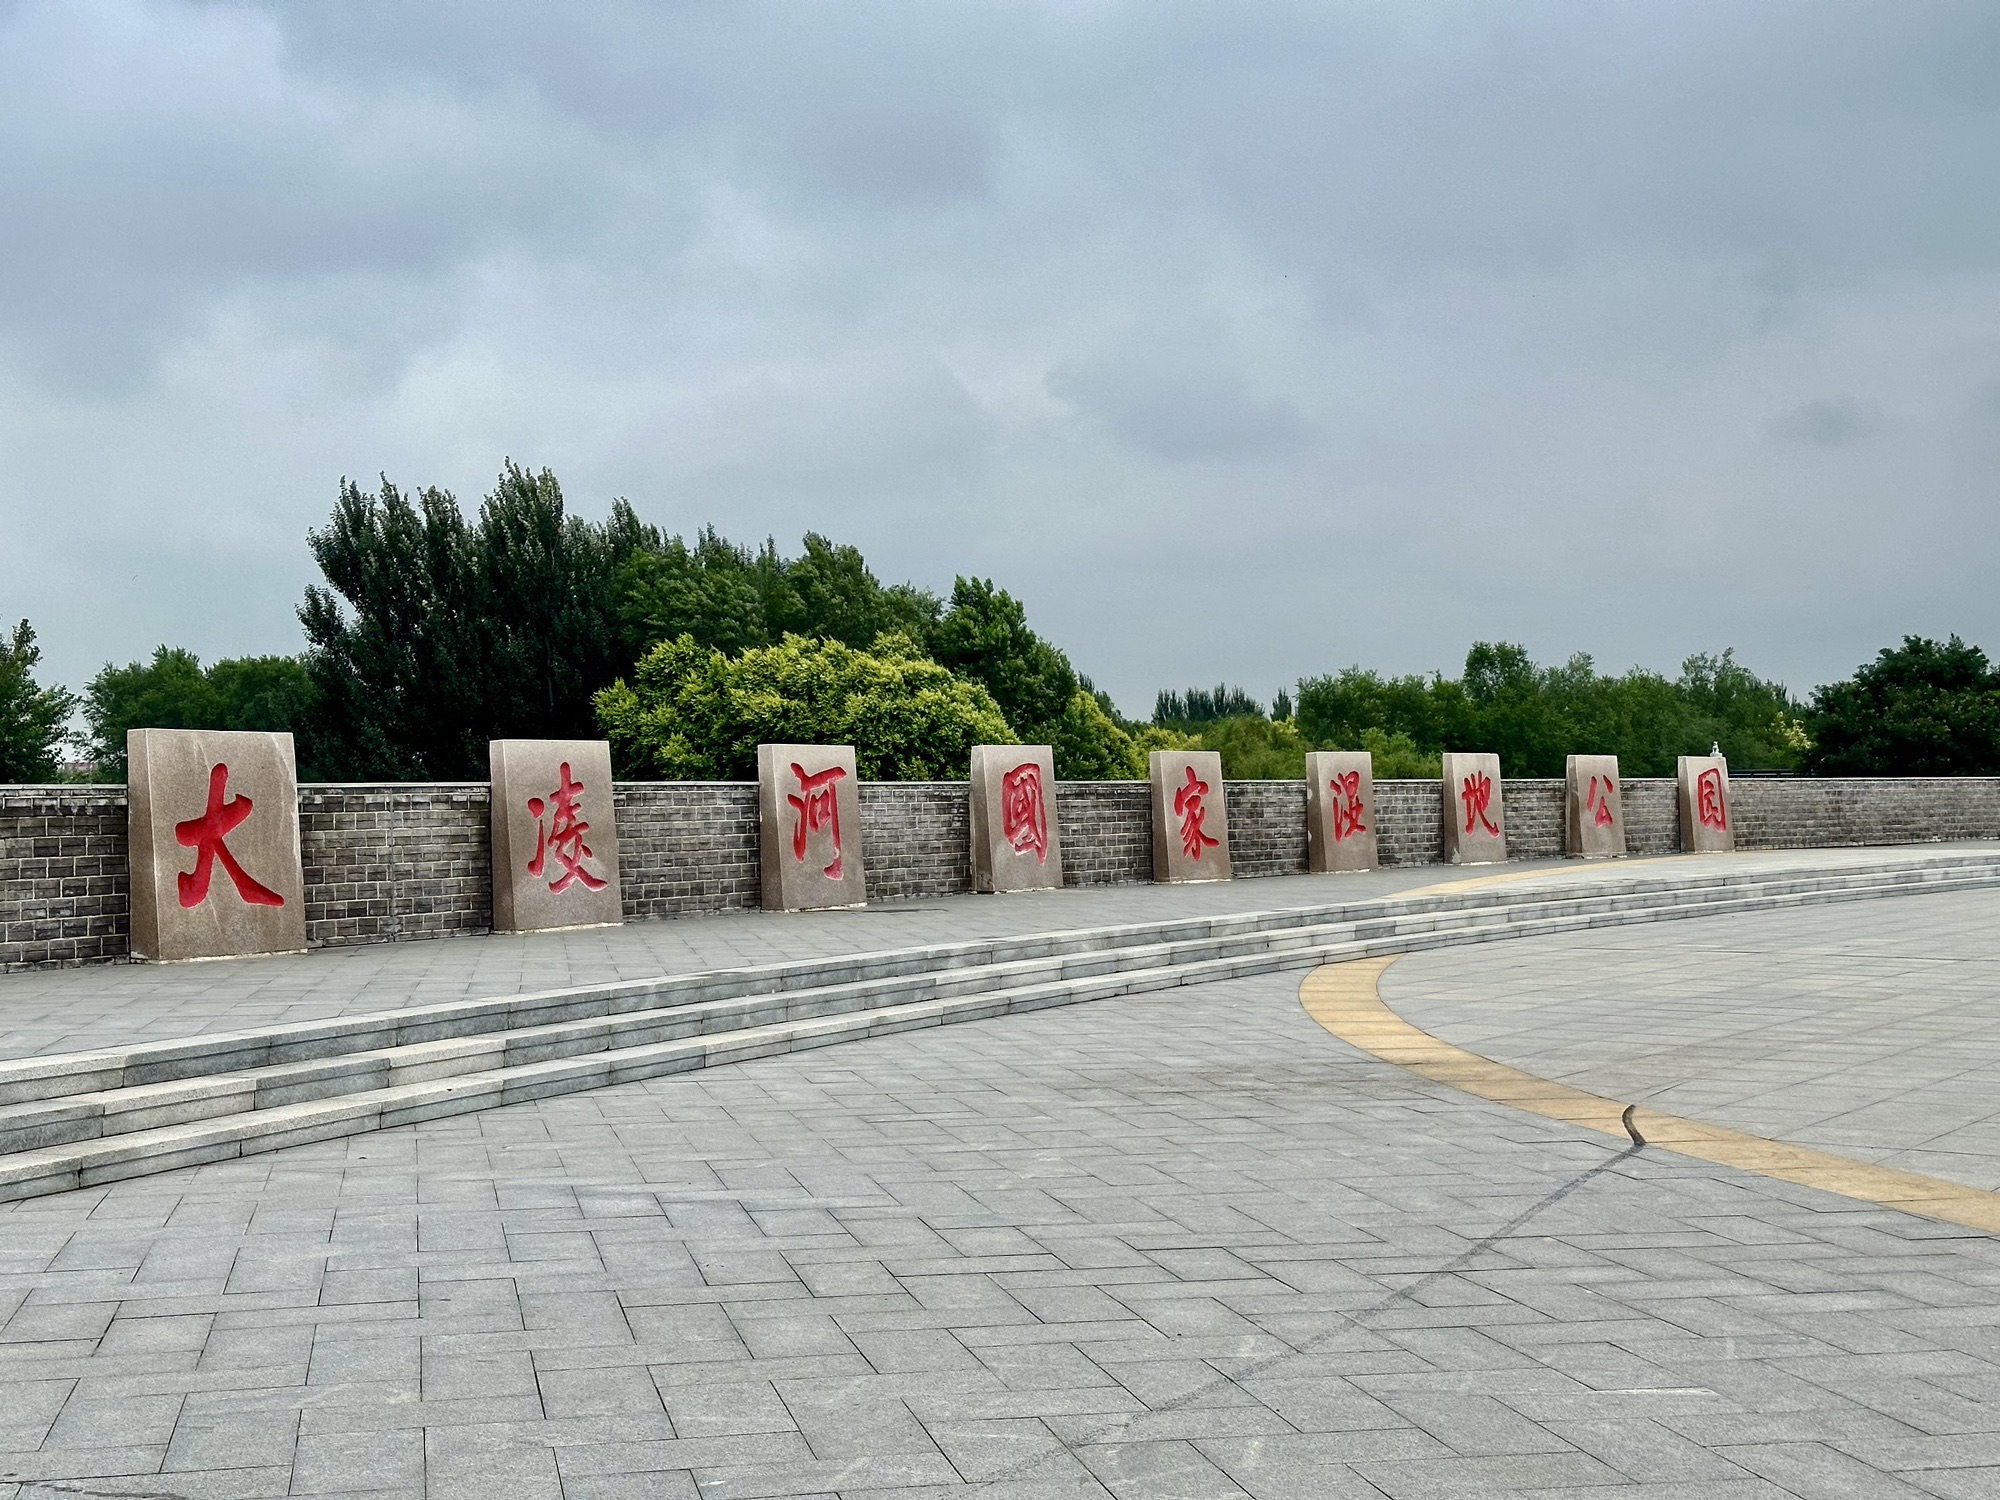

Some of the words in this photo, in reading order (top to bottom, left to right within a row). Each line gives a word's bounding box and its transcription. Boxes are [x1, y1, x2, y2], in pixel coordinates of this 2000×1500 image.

[175, 763, 284, 907] 大
[787, 762, 847, 880] 河
[1173, 766, 1220, 861] 家
[1461, 770, 1500, 838] 地
[1586, 775, 1614, 828] 公
